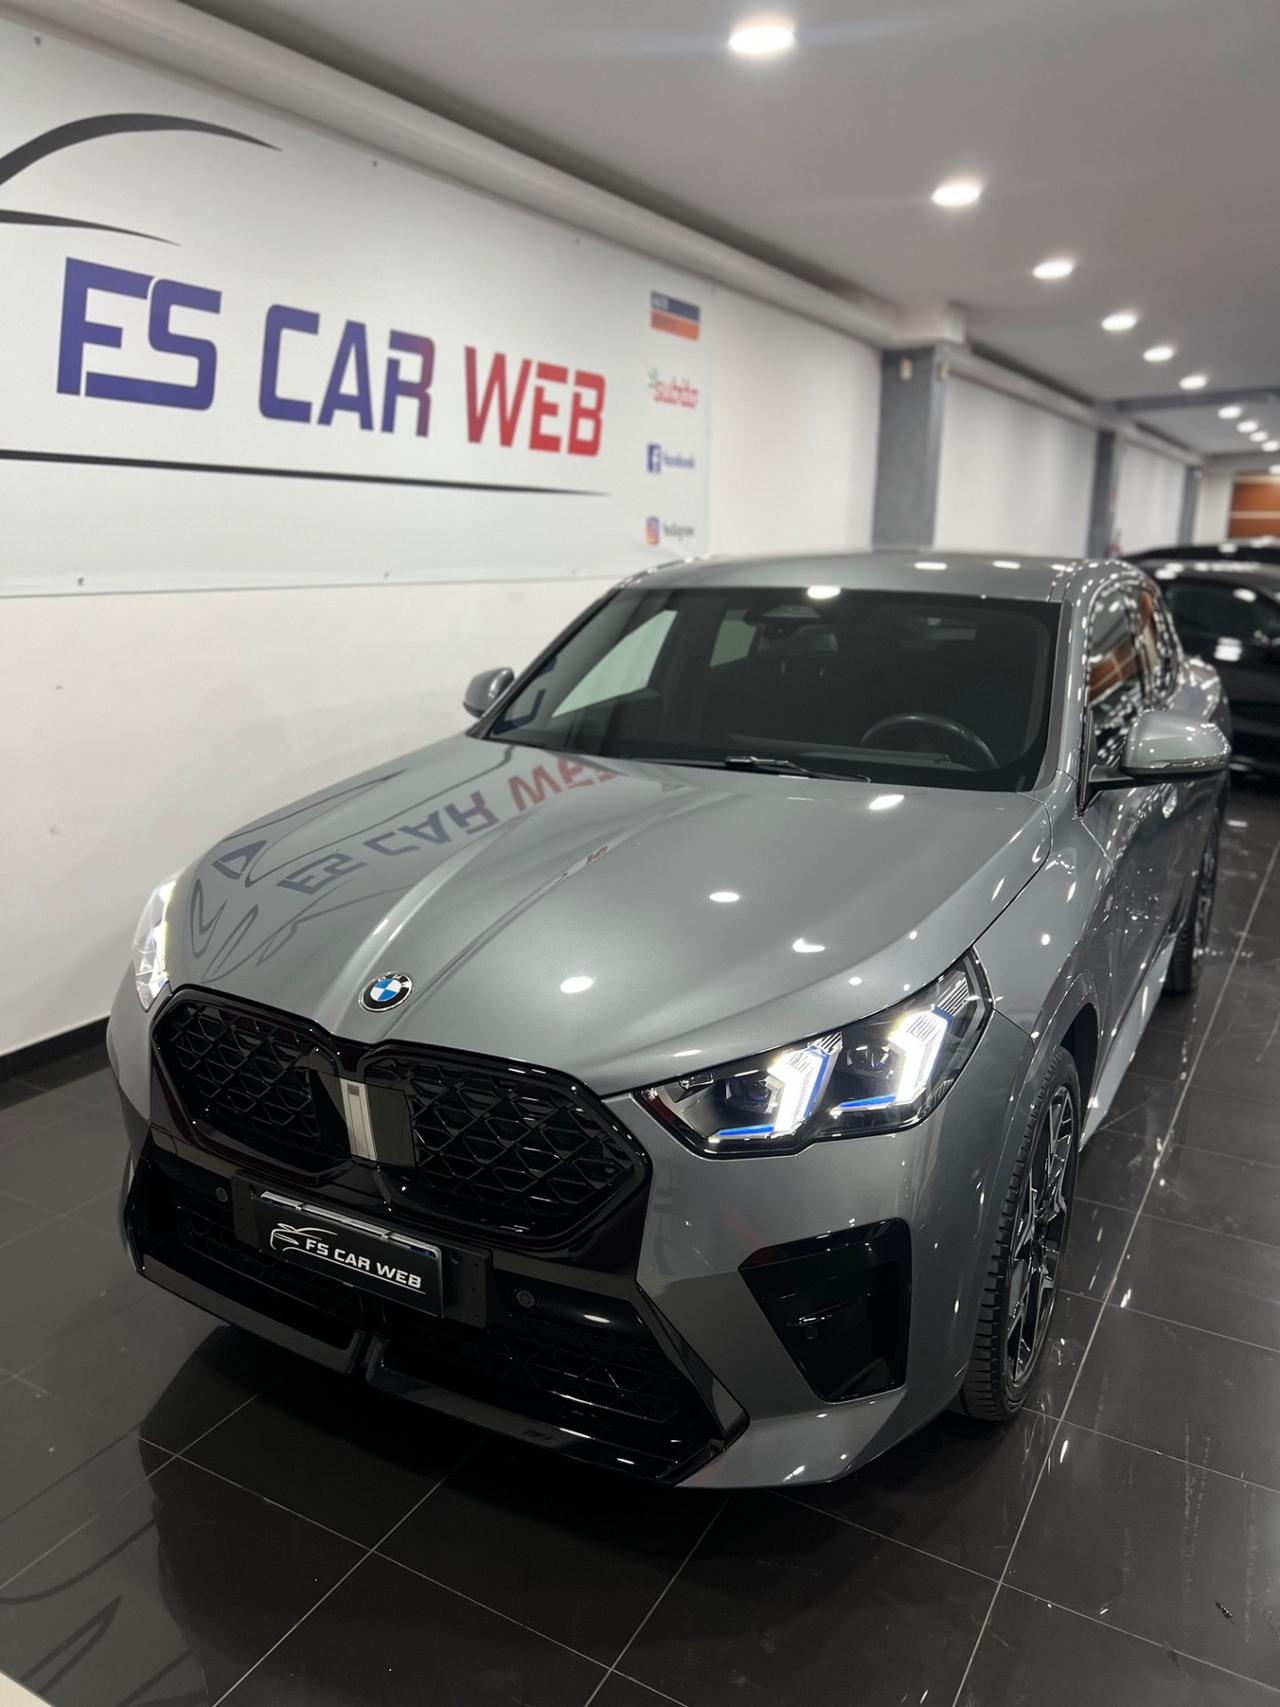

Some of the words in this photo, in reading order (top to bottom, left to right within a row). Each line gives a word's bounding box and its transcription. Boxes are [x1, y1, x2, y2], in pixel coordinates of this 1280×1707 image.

[258, 304, 436, 437] CAR
[464, 345, 607, 457] WEB
[333, 1249, 371, 1271] CAR
[376, 1262, 422, 1289] WEB
